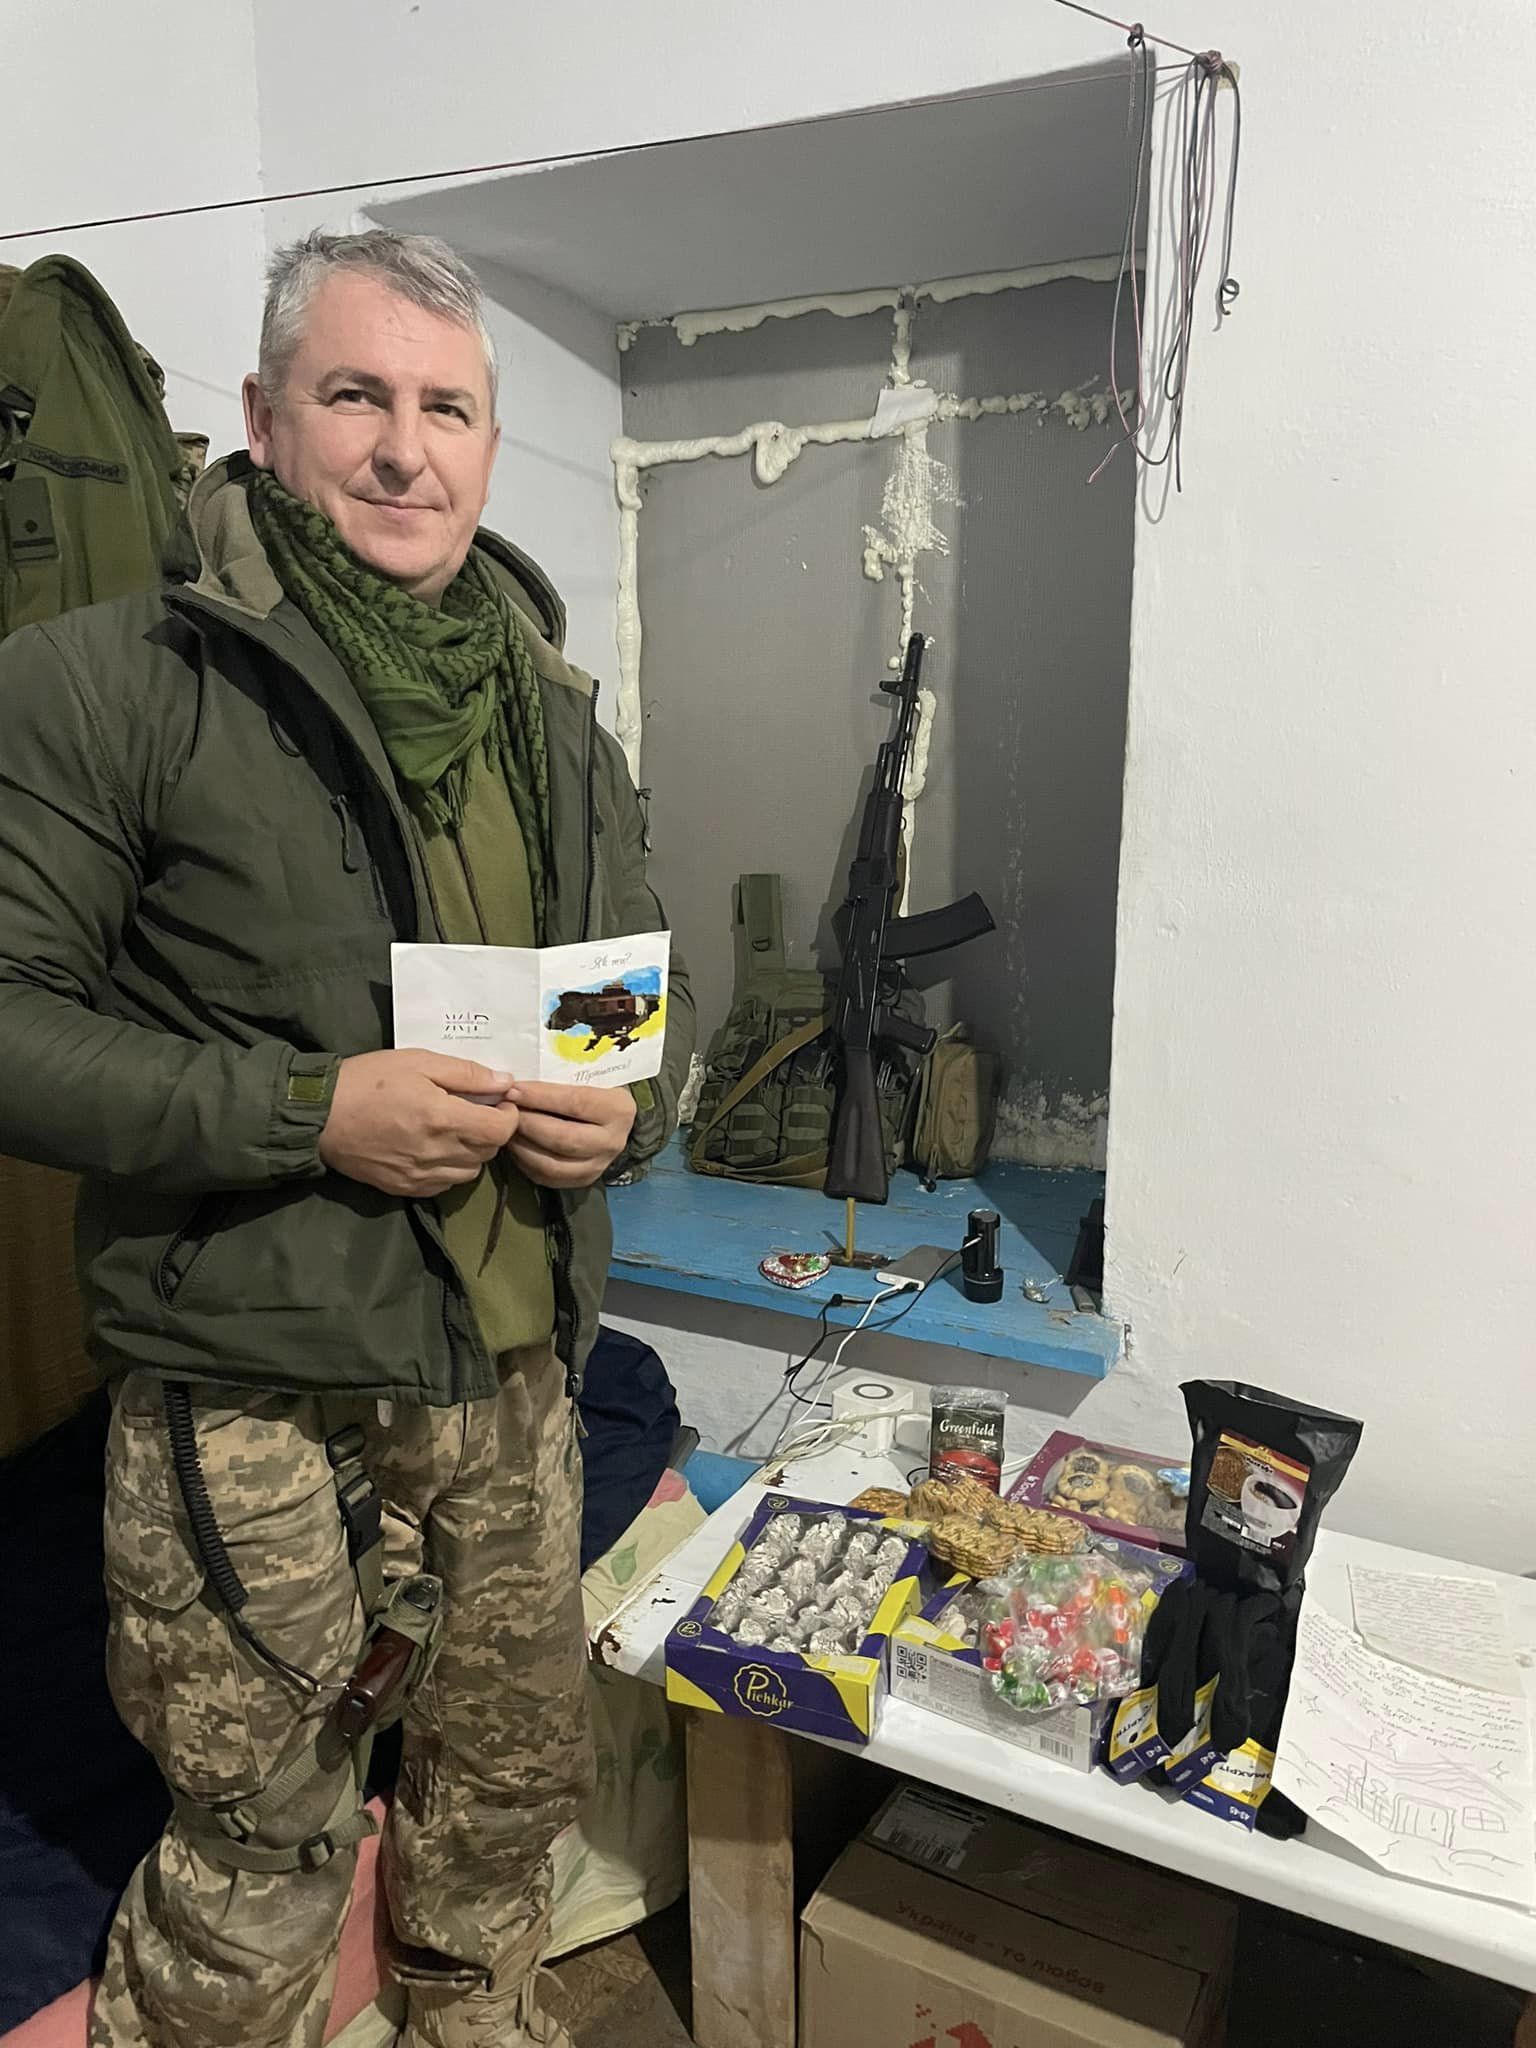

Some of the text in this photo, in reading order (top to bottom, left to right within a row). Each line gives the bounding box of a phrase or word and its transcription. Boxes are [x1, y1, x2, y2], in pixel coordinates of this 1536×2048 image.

[940, 1419, 995, 1437] Greenfield
[747, 1671, 794, 1709] Pichkar
[1228, 1804, 1251, 1821] 43-45
[896, 1899, 978, 1945] Україна
